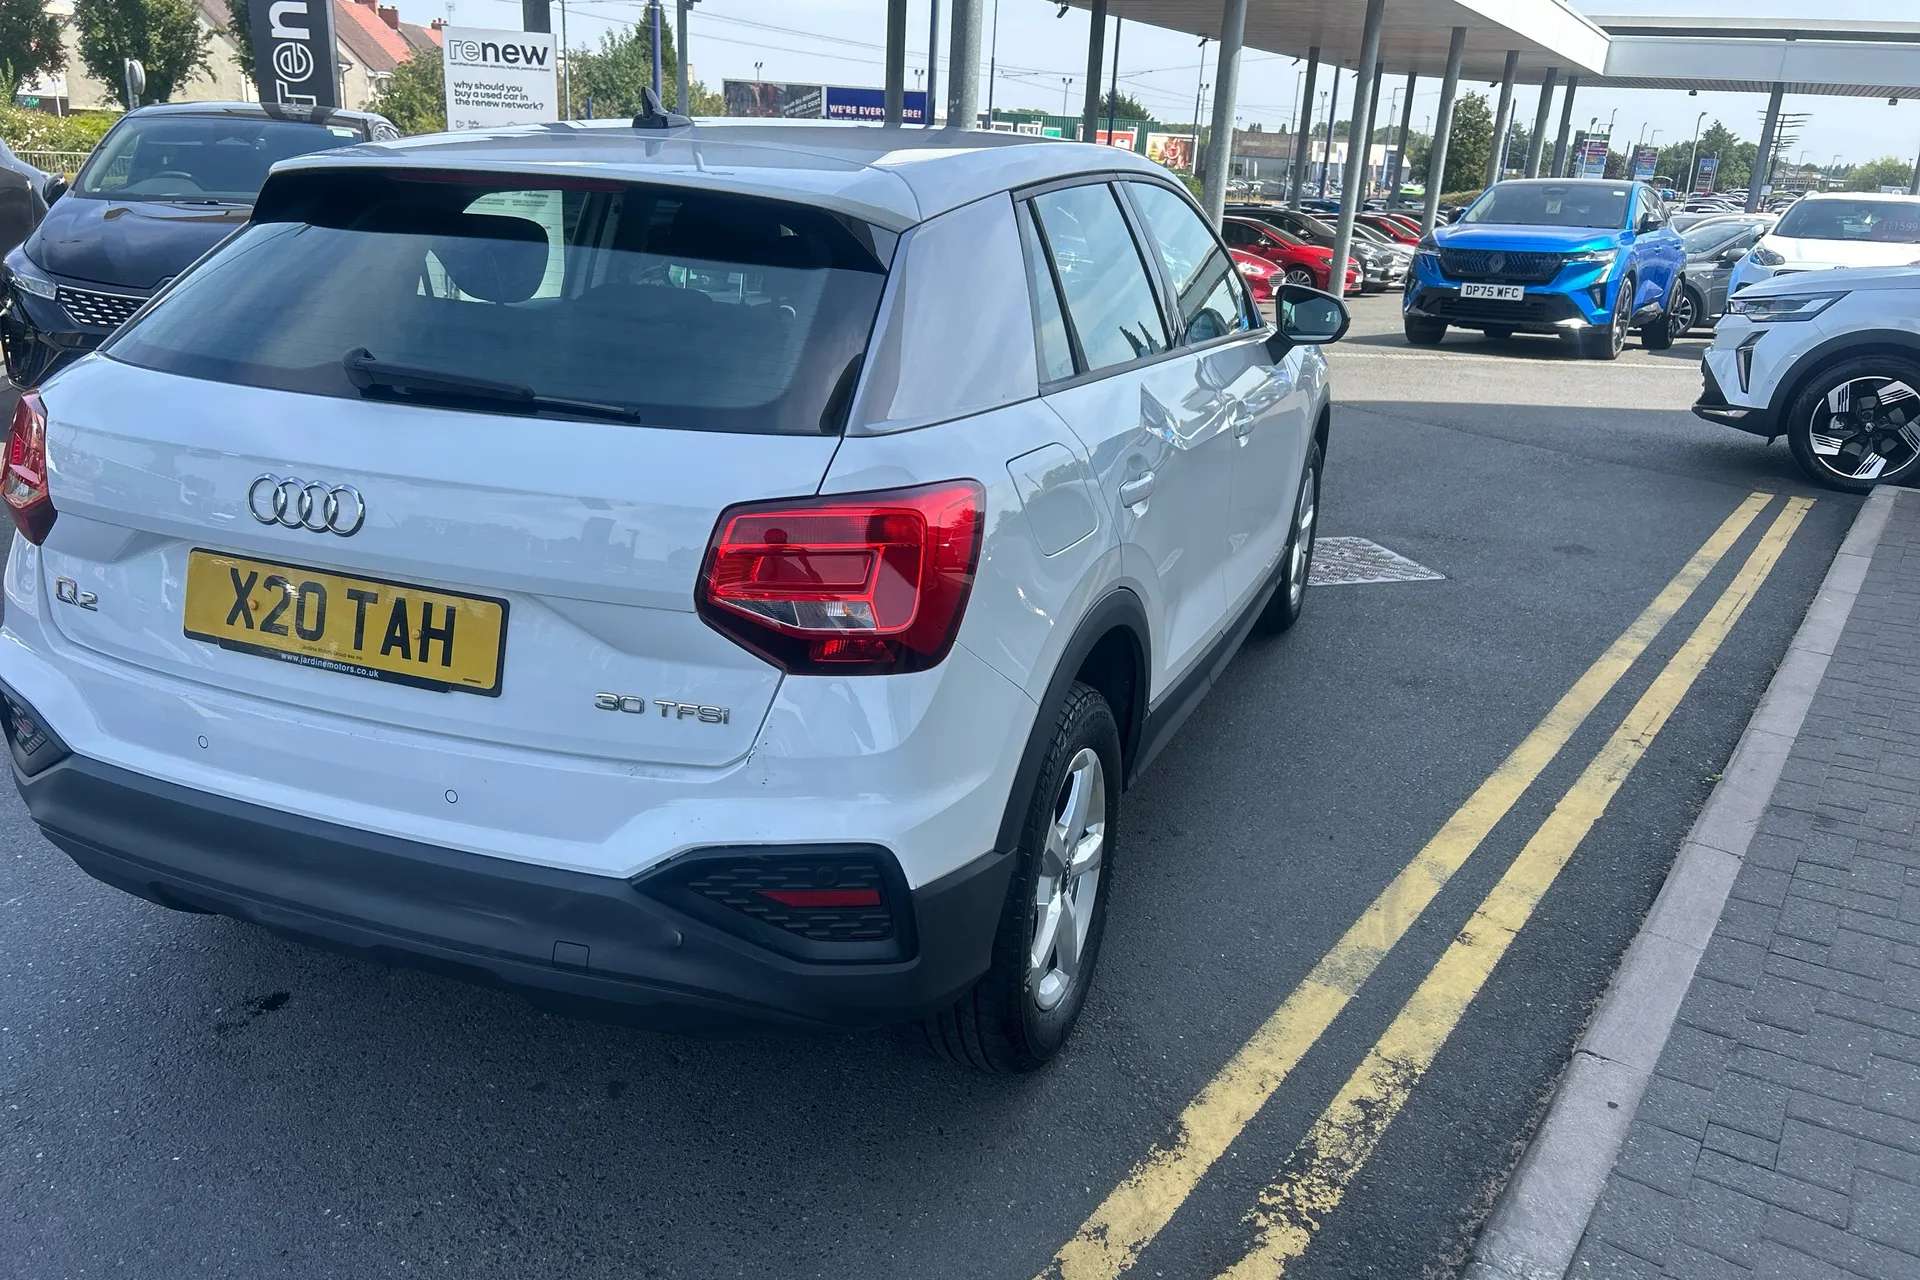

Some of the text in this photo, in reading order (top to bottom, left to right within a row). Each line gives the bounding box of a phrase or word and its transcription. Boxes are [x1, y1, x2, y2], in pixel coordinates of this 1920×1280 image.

[449, 40, 548, 65] renew
[454, 80, 523, 93] why should you
[454, 89, 471, 99] buy
[480, 91, 502, 100] used
[520, 93, 529, 101] in
[455, 98, 544, 111] the renew network?
[829, 104, 857, 114] WE'RE
[1465, 285, 1495, 297] DP75
[56, 576, 98, 612] Q2
[225, 567, 457, 667] X20 TAH
[281, 654, 379, 677] www.jardinemotors.co.uk
[594, 692, 645, 714] 30
